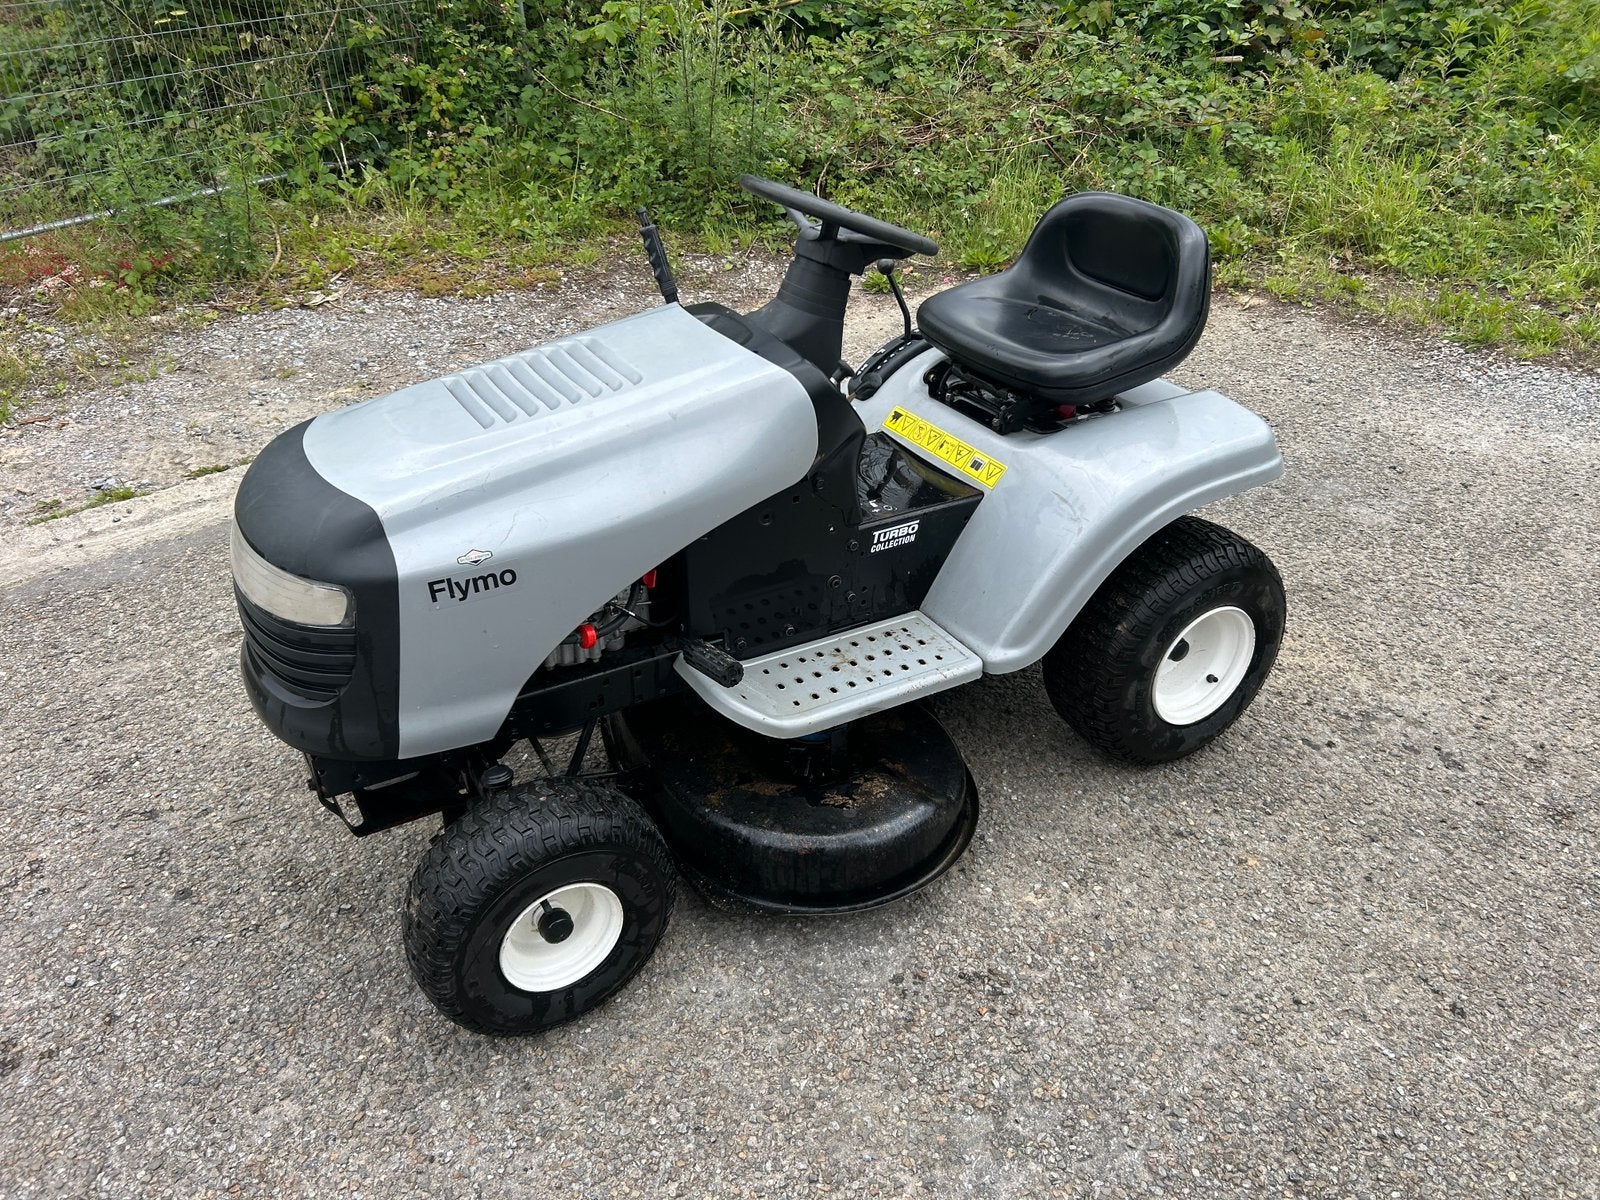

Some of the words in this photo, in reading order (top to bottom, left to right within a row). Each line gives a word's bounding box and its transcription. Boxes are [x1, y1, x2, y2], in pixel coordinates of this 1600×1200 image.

[870, 533, 916, 553] COLLECTION
[872, 519, 920, 544] TURBO
[427, 568, 517, 603] Flymo
